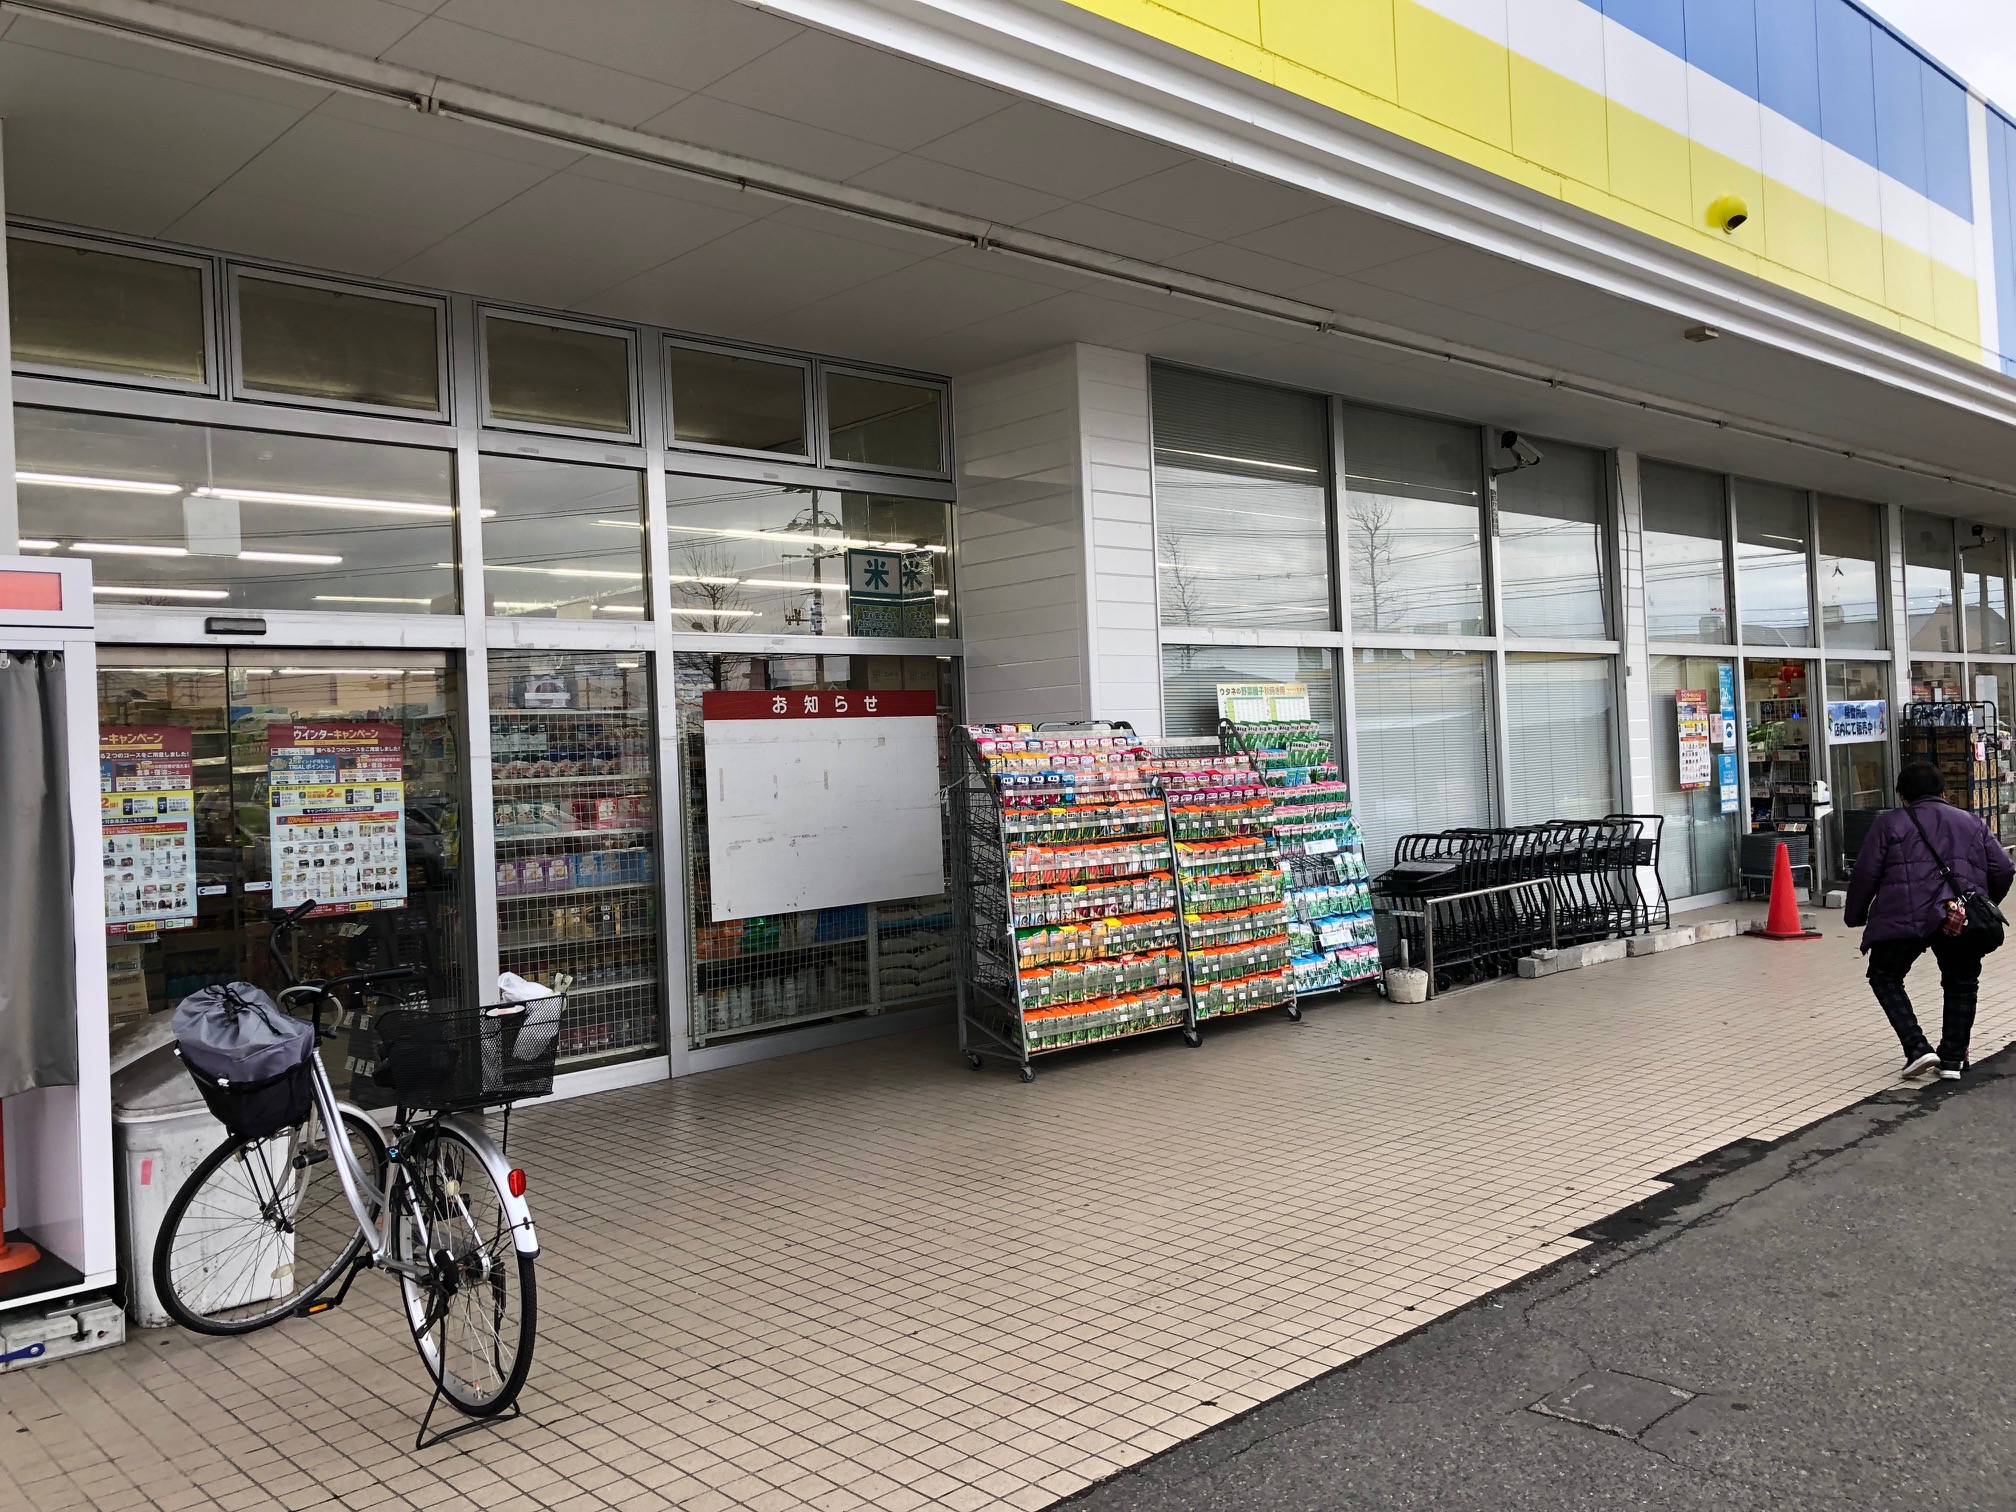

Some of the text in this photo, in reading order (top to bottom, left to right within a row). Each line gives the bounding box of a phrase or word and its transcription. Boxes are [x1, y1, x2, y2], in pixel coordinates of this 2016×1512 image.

[864, 559, 889, 590] 米
[772, 694, 878, 715] お知らせ
[293, 729, 379, 740] ウインターキャンペーン
